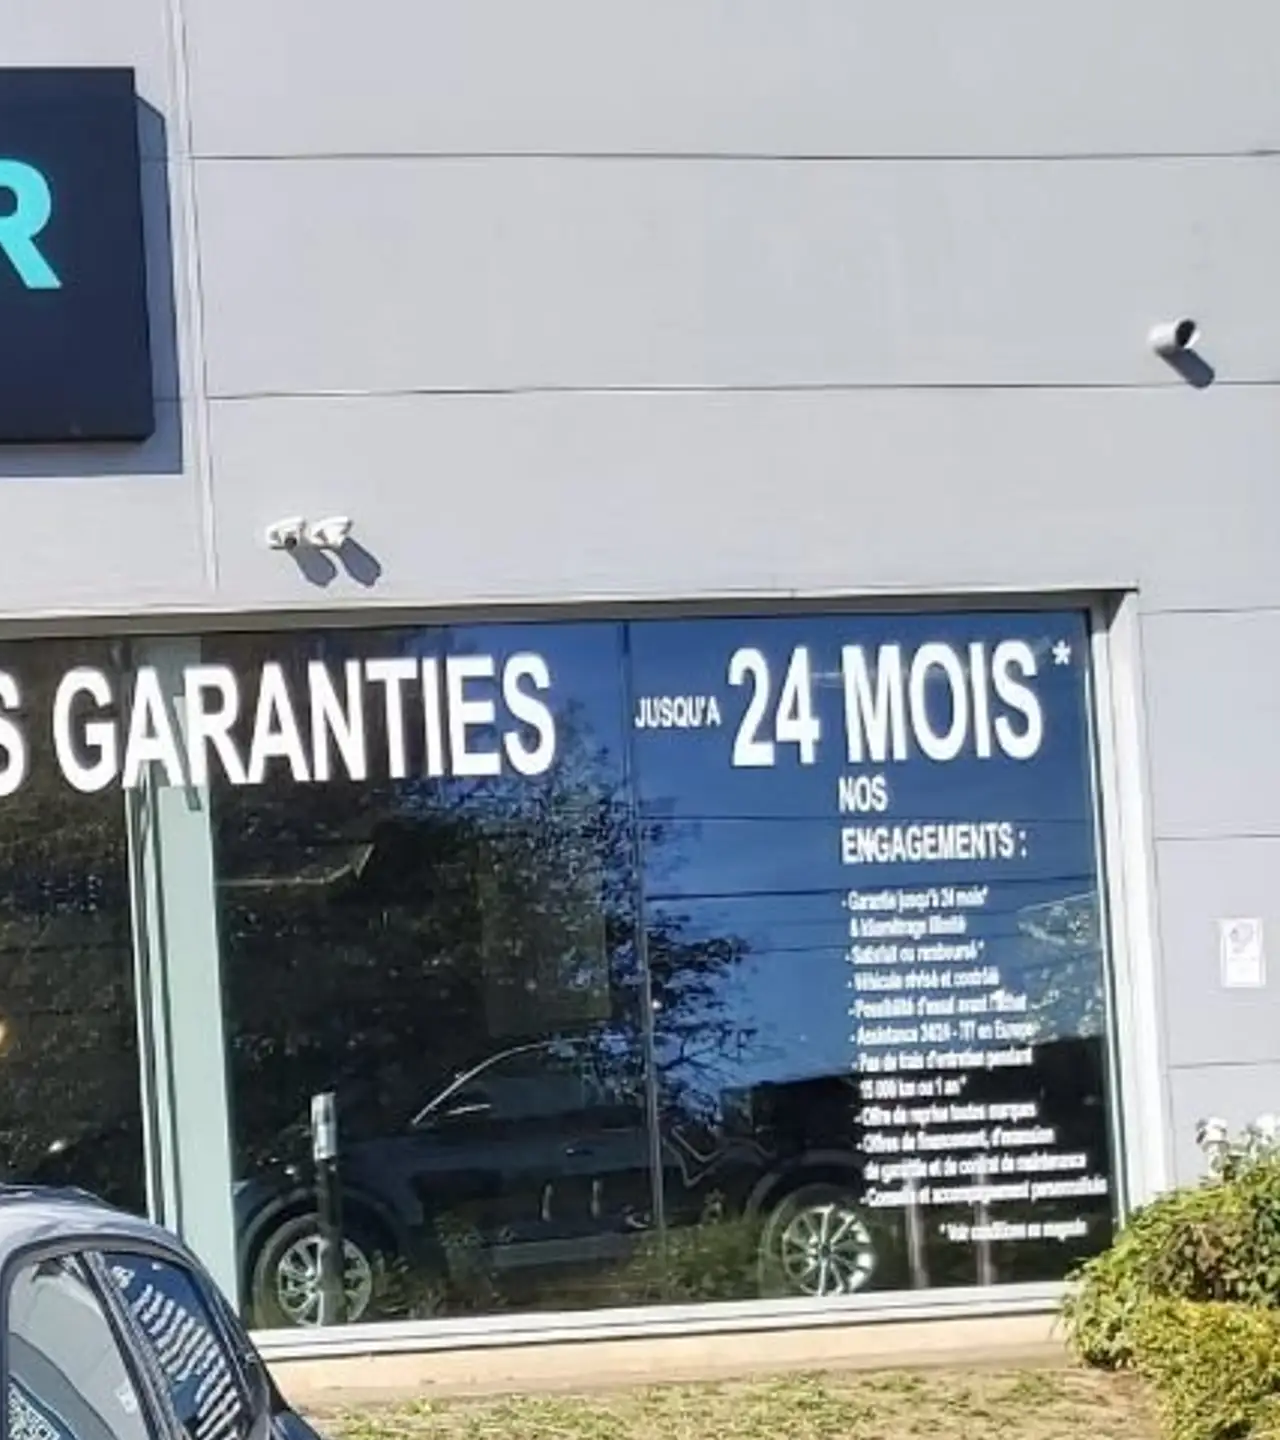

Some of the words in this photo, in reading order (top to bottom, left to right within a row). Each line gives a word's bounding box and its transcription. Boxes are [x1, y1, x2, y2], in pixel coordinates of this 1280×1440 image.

[52, 652, 557, 792] GARANTIES
[634, 697, 721, 730] JUSQU'A
[727, 647, 819, 767] 24
[839, 775, 889, 812] NOS
[842, 822, 1014, 864] ENGAGEMENTS
